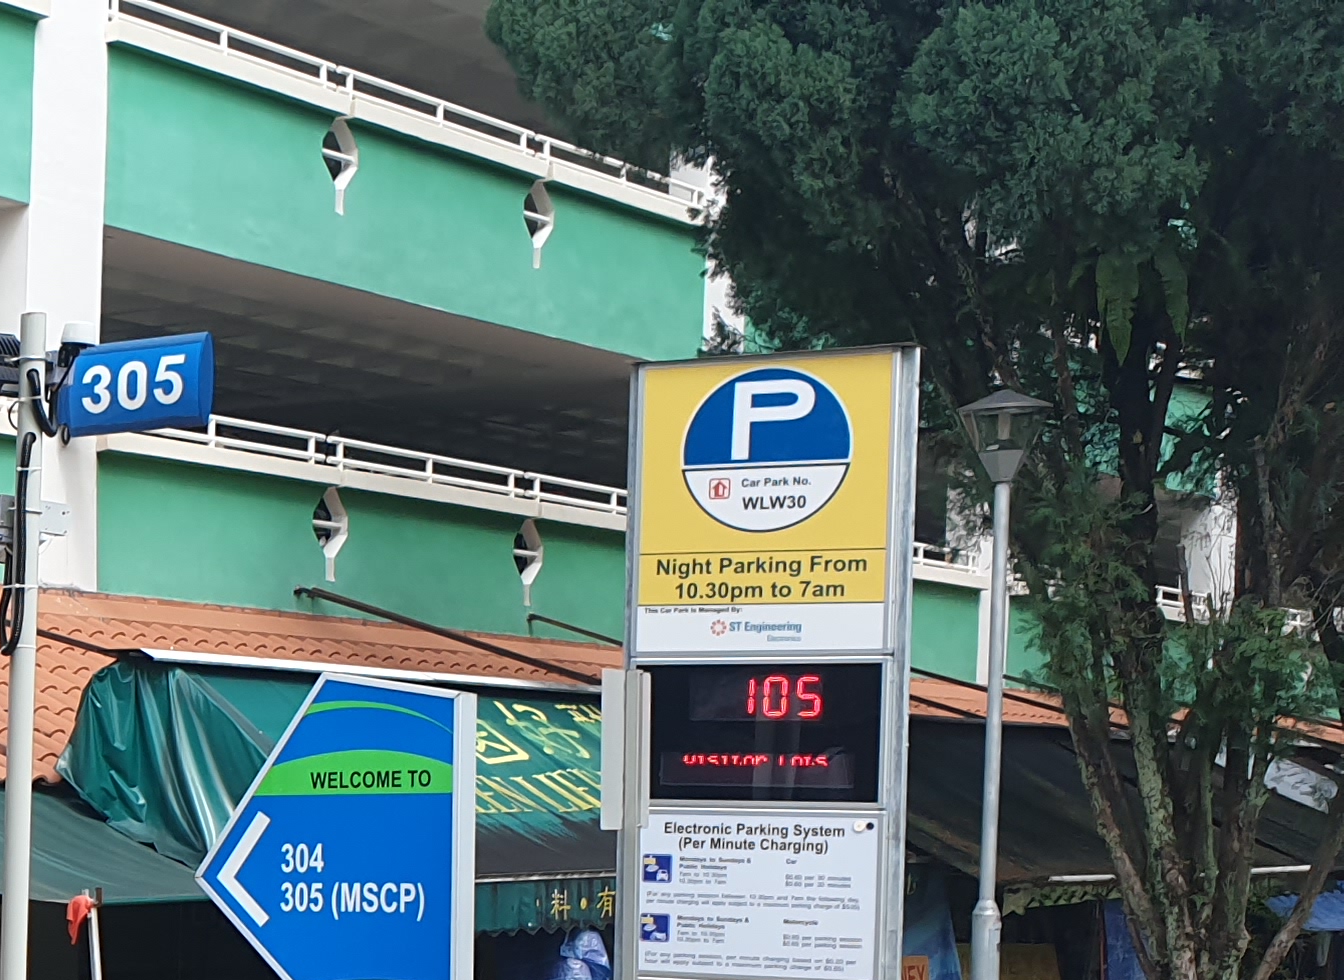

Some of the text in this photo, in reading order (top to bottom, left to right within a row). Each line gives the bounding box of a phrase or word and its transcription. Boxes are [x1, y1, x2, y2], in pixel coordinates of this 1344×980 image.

[81, 354, 186, 414] 305
[730, 378, 817, 461] P
[741, 475, 811, 487] Car Park No.
[742, 495, 807, 511] WLW30
[656, 554, 868, 579] Night Parking From
[674, 580, 846, 602] 10.30pm to 7am
[729, 621, 802, 633] ST Engineering
[746, 675, 822, 717] 105
[310, 769, 431, 789] WELCOME TO
[664, 821, 846, 840] Electronic Parking System
[678, 836, 829, 855] (Per Minute Charging)
[280, 843, 324, 873] 304
[280, 881, 426, 921] 305 (MSCP)
